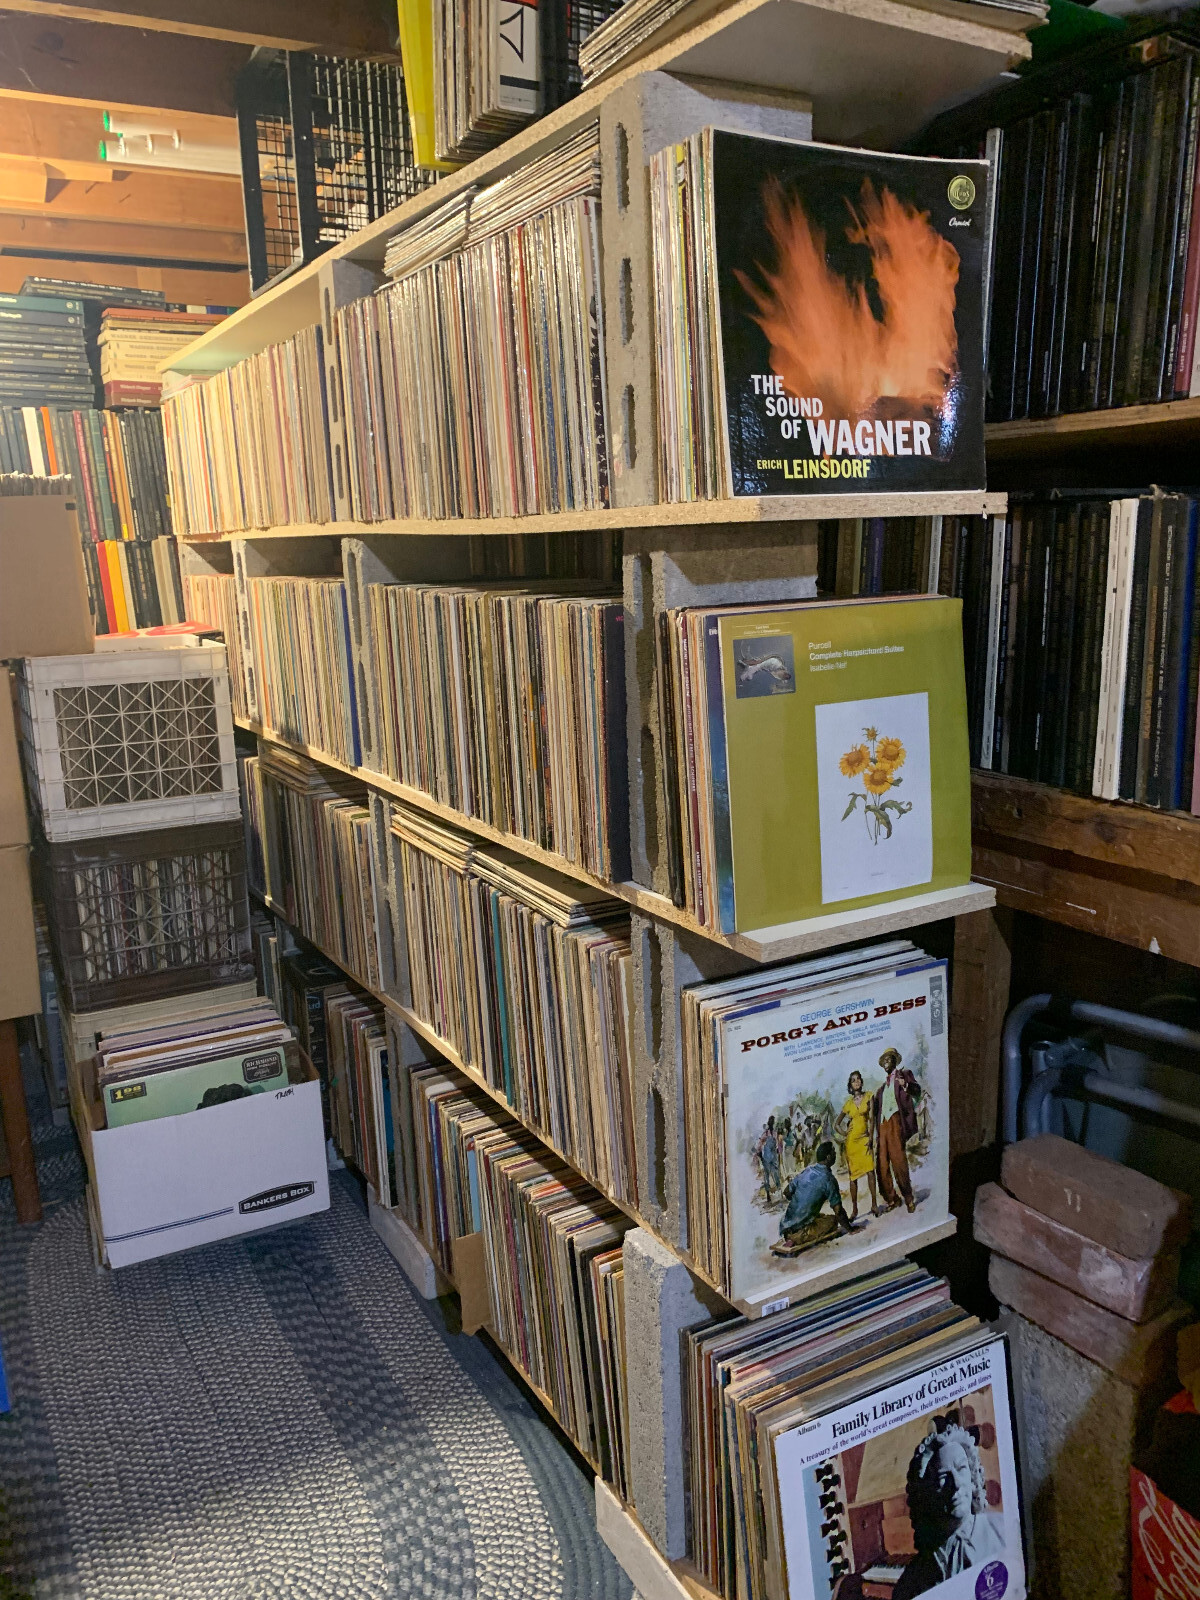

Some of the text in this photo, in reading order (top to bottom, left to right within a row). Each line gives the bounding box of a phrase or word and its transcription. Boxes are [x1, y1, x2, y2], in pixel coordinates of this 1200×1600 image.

[751, 374, 785, 396] THE
[765, 396, 824, 417] SOUND
[780, 419, 932, 456] OF WAGNER
[756, 458, 872, 479] ERICH LEINSDORF
[808, 640, 832, 650] Purcell
[810, 646, 904, 660] Complete Harpsichord Suites
[800, 998, 875, 1022] GEORGE GERSHWIN
[740, 996, 926, 1053] PORGY AND BESS
[784, 1050, 798, 1058] AVON
[244, 1186, 310, 1210] BANKERS BOX
[930, 1366, 950, 1378] FUNK
[954, 1346, 990, 1370] WAGNALLS
[832, 1358, 991, 1438] Family Library of Great Music
[797, 1424, 817, 1437] Album
[806, 1447, 831, 1464] treasury
[832, 1441, 840, 1450] of
[840, 1438, 850, 1447] the
[850, 1428, 871, 1443] world's
[872, 1423, 888, 1434] great
[920, 1402, 934, 1411] their
[934, 1395, 949, 1407] lives,
[950, 1388, 966, 1400] music,
[967, 1382, 978, 1390] and
[978, 1374, 992, 1385] times
